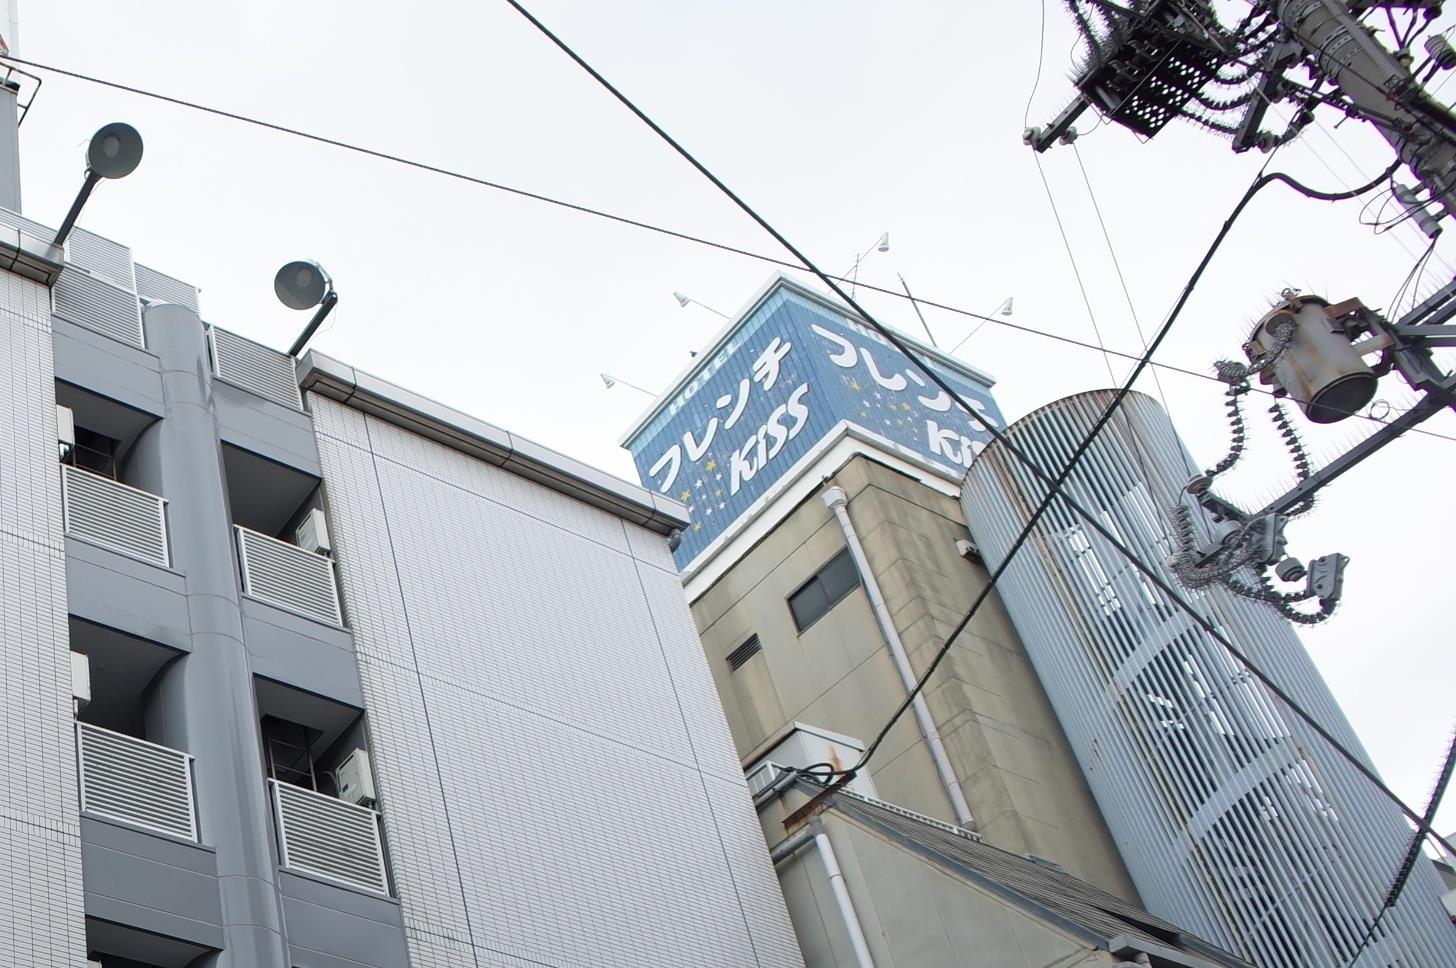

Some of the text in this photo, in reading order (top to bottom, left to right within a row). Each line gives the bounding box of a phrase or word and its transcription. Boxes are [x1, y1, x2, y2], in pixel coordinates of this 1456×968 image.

[649, 337, 791, 493] フレンチ
[669, 340, 741, 415] HOTEL
